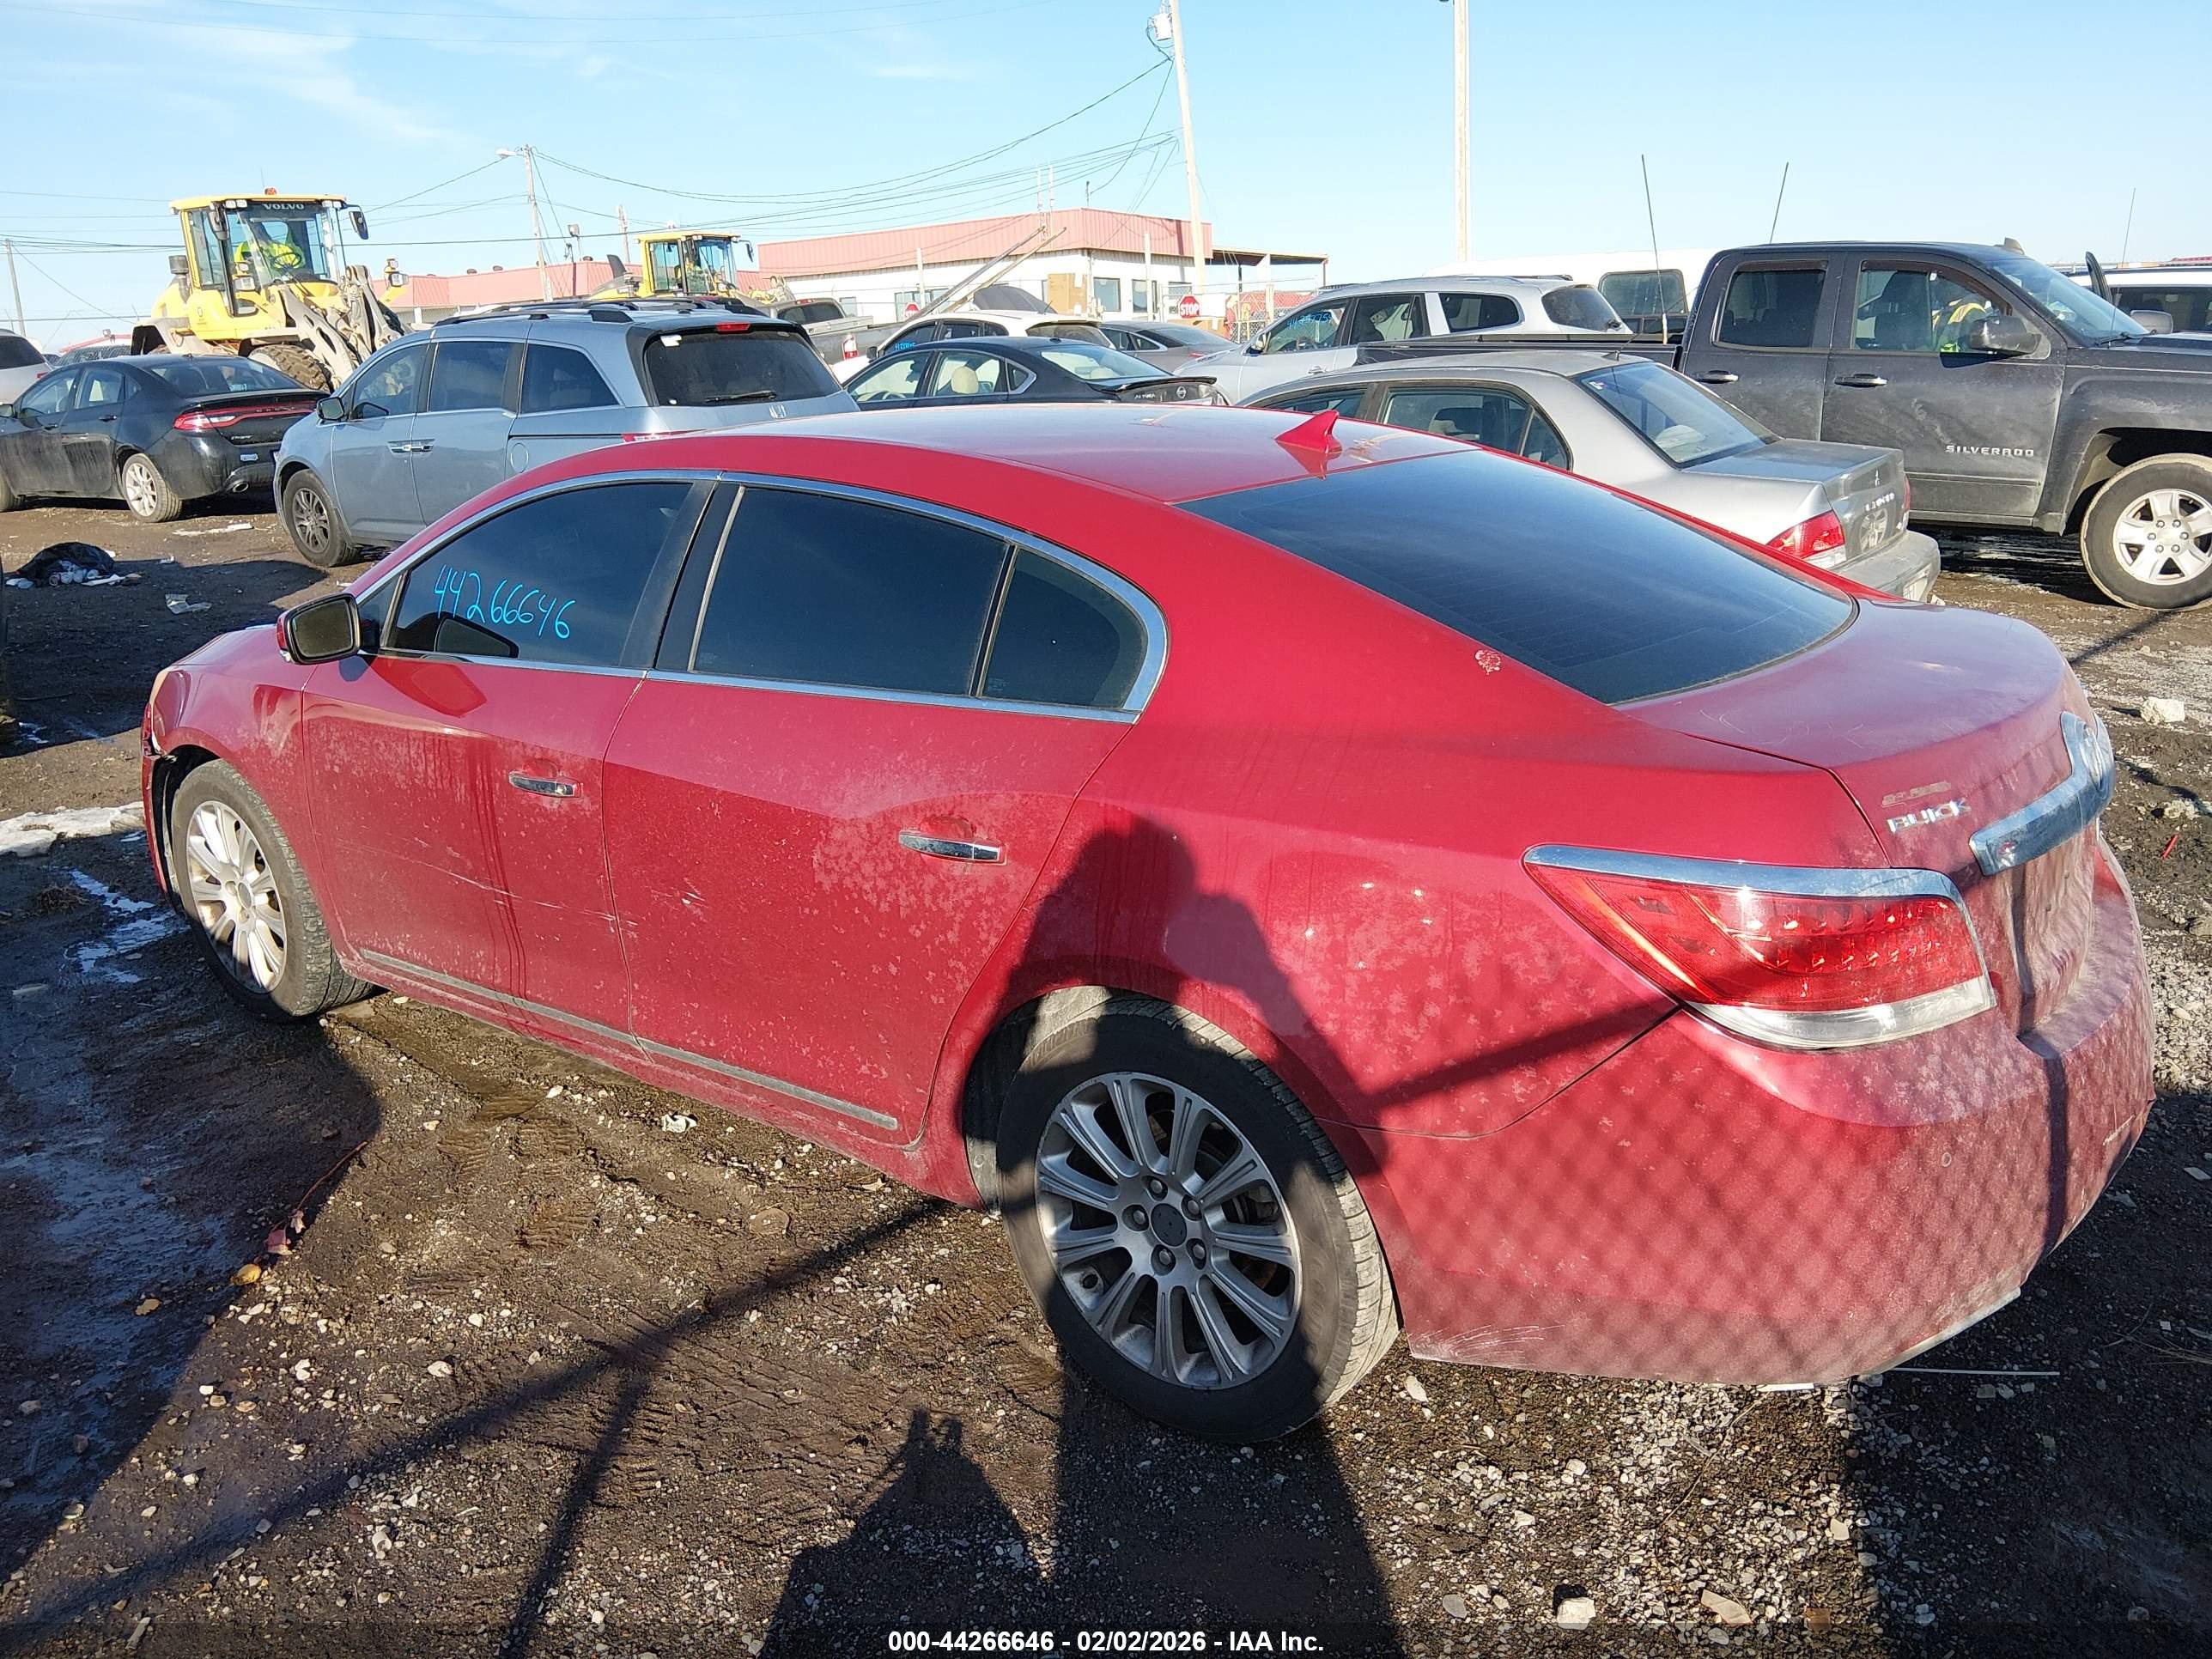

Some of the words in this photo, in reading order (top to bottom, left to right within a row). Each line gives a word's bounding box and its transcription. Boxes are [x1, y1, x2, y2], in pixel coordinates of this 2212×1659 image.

[1180, 303, 1200, 316] STOP
[1945, 445, 2034, 458] SILVERADO
[434, 564, 575, 639] 44266646
[1887, 798, 1972, 833] BUICK
